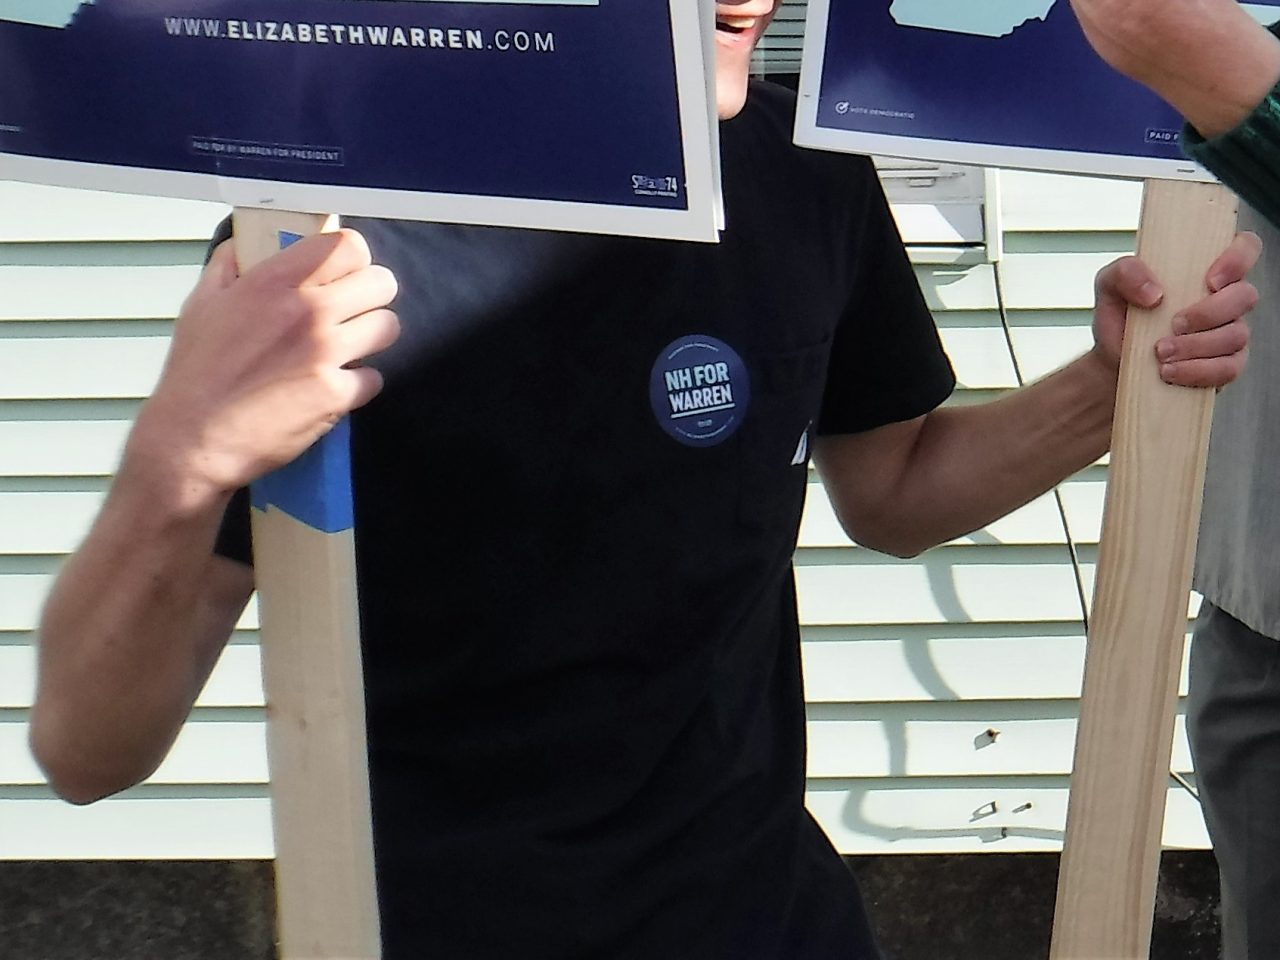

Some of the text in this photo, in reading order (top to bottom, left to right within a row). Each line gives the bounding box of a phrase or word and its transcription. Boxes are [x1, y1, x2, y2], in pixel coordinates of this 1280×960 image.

[164, 16, 555, 53] WWW.ELIZABETHWARREN.COM
[1150, 131, 1170, 140] PAID
[665, 362, 730, 392] NH FOR
[668, 383, 734, 413] WARREN
